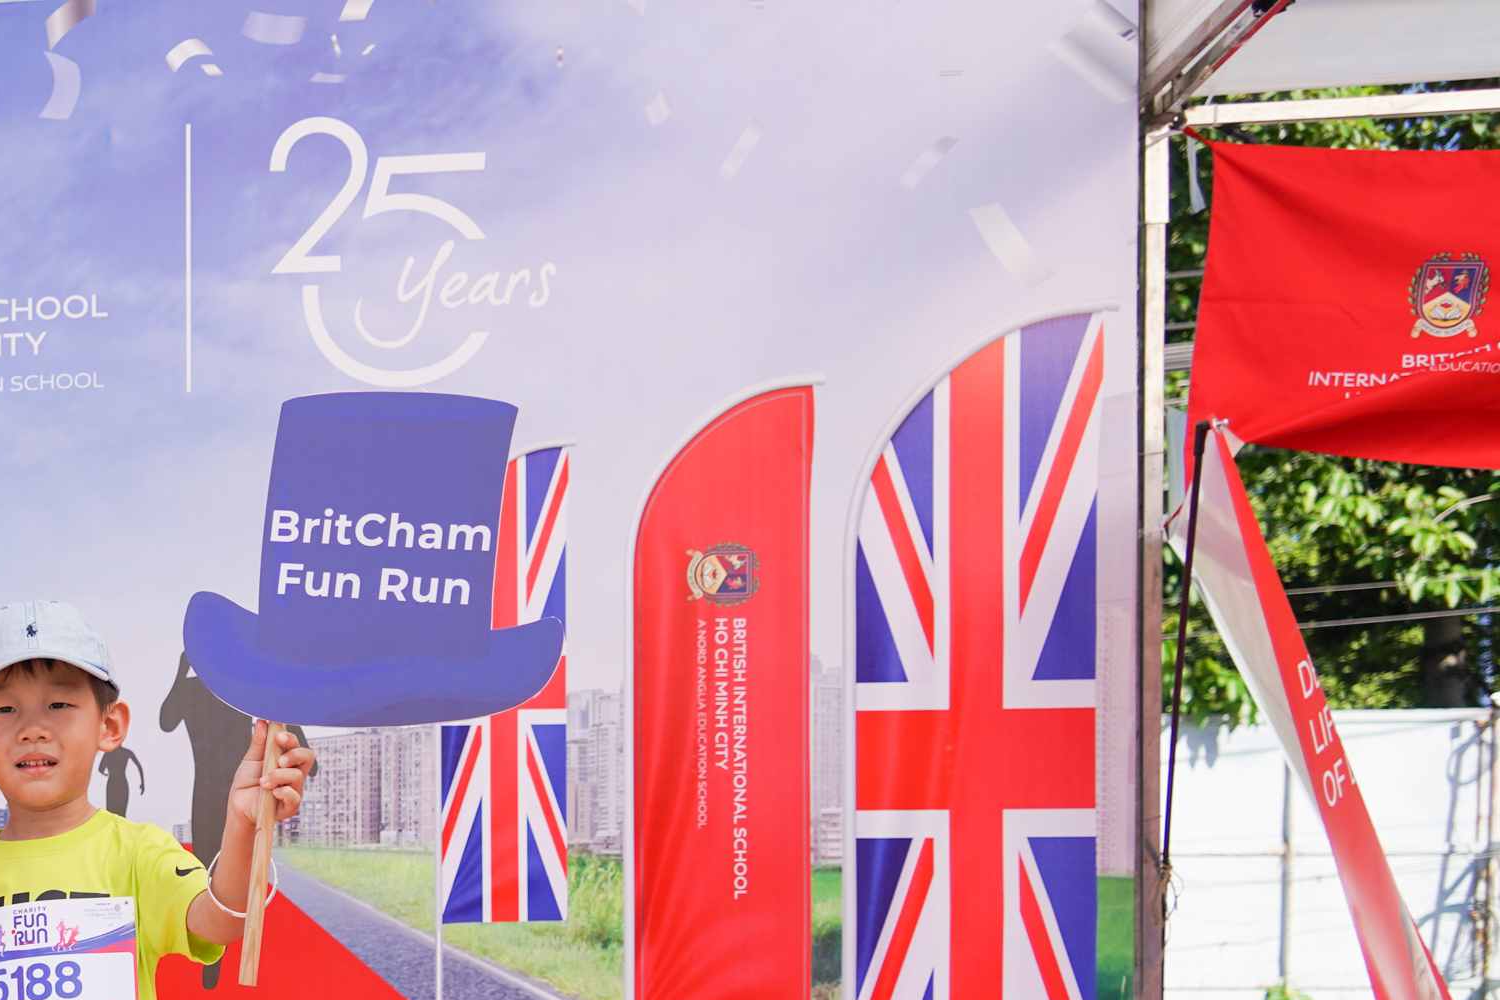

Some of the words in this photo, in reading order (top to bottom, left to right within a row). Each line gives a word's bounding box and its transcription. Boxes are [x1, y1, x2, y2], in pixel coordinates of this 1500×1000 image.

[269, 116, 490, 387] 25
[354, 240, 556, 349] Years
[10, 372, 105, 392] SCHOOL
[269, 508, 492, 551] BritCham
[276, 562, 361, 599] Fun
[378, 567, 471, 605] Run
[697, 630, 708, 664] NORD
[714, 617, 728, 643] HO
[732, 617, 747, 682] BRITISH
[714, 647, 728, 677] CHI
[697, 666, 708, 709] ANGLIA
[715, 681, 729, 727] MINH
[697, 712, 708, 778] EDUCATION
[715, 732, 729, 770] CITY
[732, 686, 747, 823] INTERNATIONAL
[1323, 759, 1346, 807] OF
[697, 782, 708, 828] SCHOOL
[733, 827, 748, 899] SCHOOL
[13, 913, 48, 929] FUN
[14, 928, 48, 946] RUN
